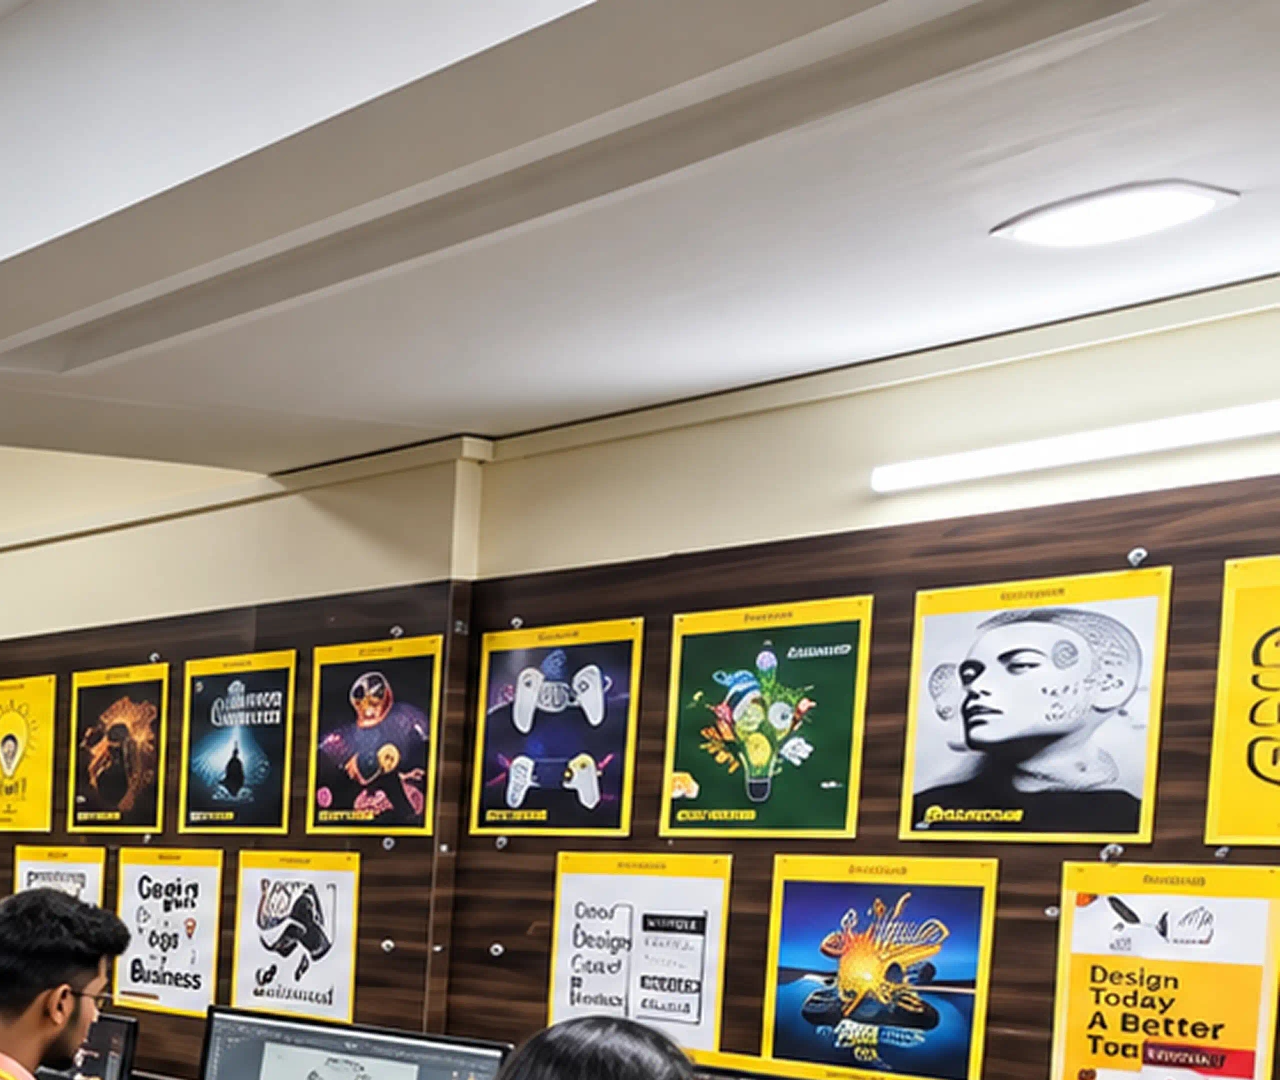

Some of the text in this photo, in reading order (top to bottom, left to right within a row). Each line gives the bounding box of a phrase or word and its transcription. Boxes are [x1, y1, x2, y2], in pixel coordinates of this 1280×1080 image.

[130, 957, 202, 990] Business
[1089, 964, 1180, 992] Design
[1089, 987, 1176, 1014] Today
[1087, 1010, 1225, 1040] A Better
